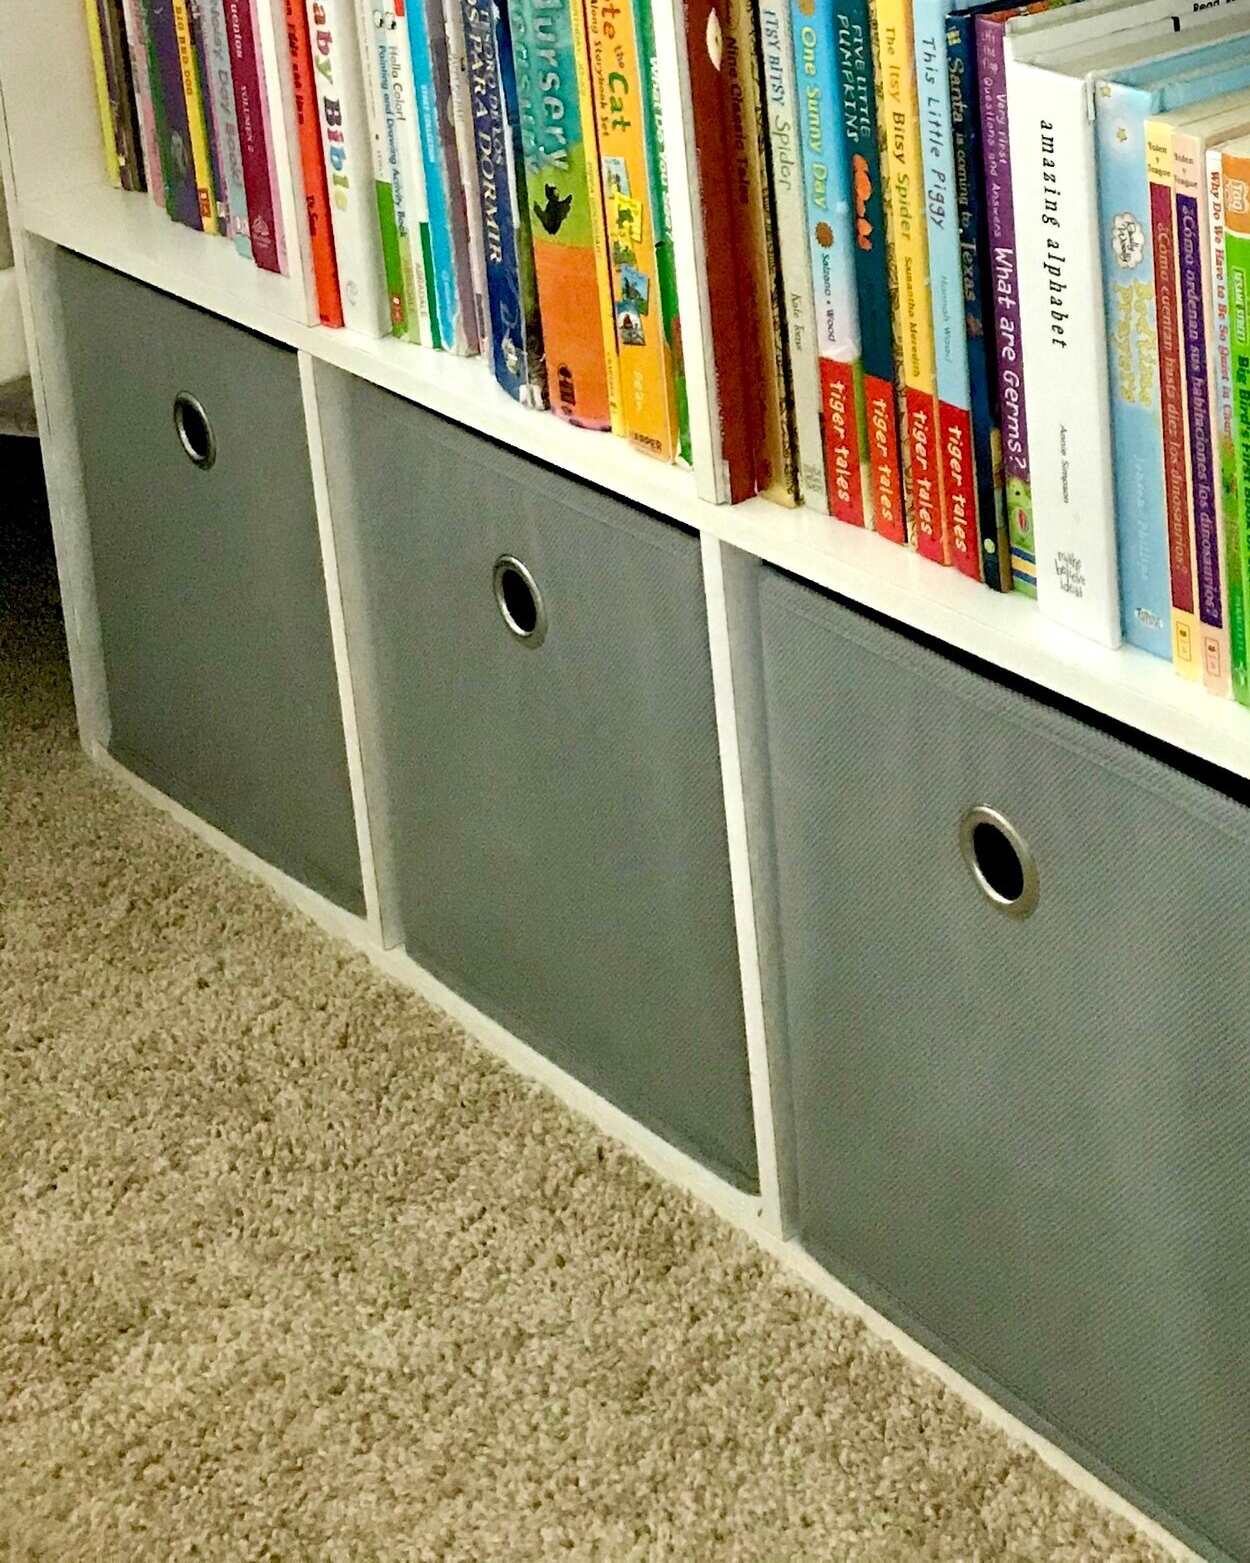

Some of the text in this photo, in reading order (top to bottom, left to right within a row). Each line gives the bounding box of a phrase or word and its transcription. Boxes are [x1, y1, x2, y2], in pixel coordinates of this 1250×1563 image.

[176, 5, 184, 31] BIG
[179, 34, 190, 65] RED
[379, 45, 389, 90] Painting
[388, 46, 401, 78] Hello
[614, 44, 625, 69] the
[184, 71, 193, 96] DOG
[594, 39, 607, 109] Storybook
[838, 14, 860, 143] PUMPKINS
[384, 91, 394, 117] and
[608, 71, 631, 133] Cat
[763, 10, 795, 191] ITSY BITSY Spider
[801, 27, 829, 210] One Sunny Day
[983, 76, 994, 146] Questions
[385, 117, 397, 165] Drawing
[468, 33, 488, 118] PARA
[478, 130, 503, 263] DORMIR
[600, 116, 609, 137] Set
[885, 27, 910, 242] The Itsy Bitsy Spider
[922, 37, 947, 231] This Little Piggy
[323, 95, 350, 212] Bible
[987, 150, 997, 177] and
[987, 181, 1001, 238] Answers
[1211, 172, 1220, 199] Why
[397, 211, 408, 237] Book
[1040, 119, 1069, 349] amazing alphabet
[1213, 202, 1221, 220] Do
[1214, 226, 1223, 244] We
[1215, 249, 1224, 281] Have
[1218, 285, 1225, 299] to
[1218, 303, 1227, 320] Be
[1219, 324, 1228, 341] So
[993, 246, 1027, 471] What are Germs?
[1237, 354, 1250, 385] Big
[828, 381, 851, 503] tiger tales
[872, 398, 892, 522] tiger tales
[1060, 424, 1070, 504] Annie Simpson
[911, 409, 933, 538] tiger tales
[947, 425, 968, 554] tiger tales
